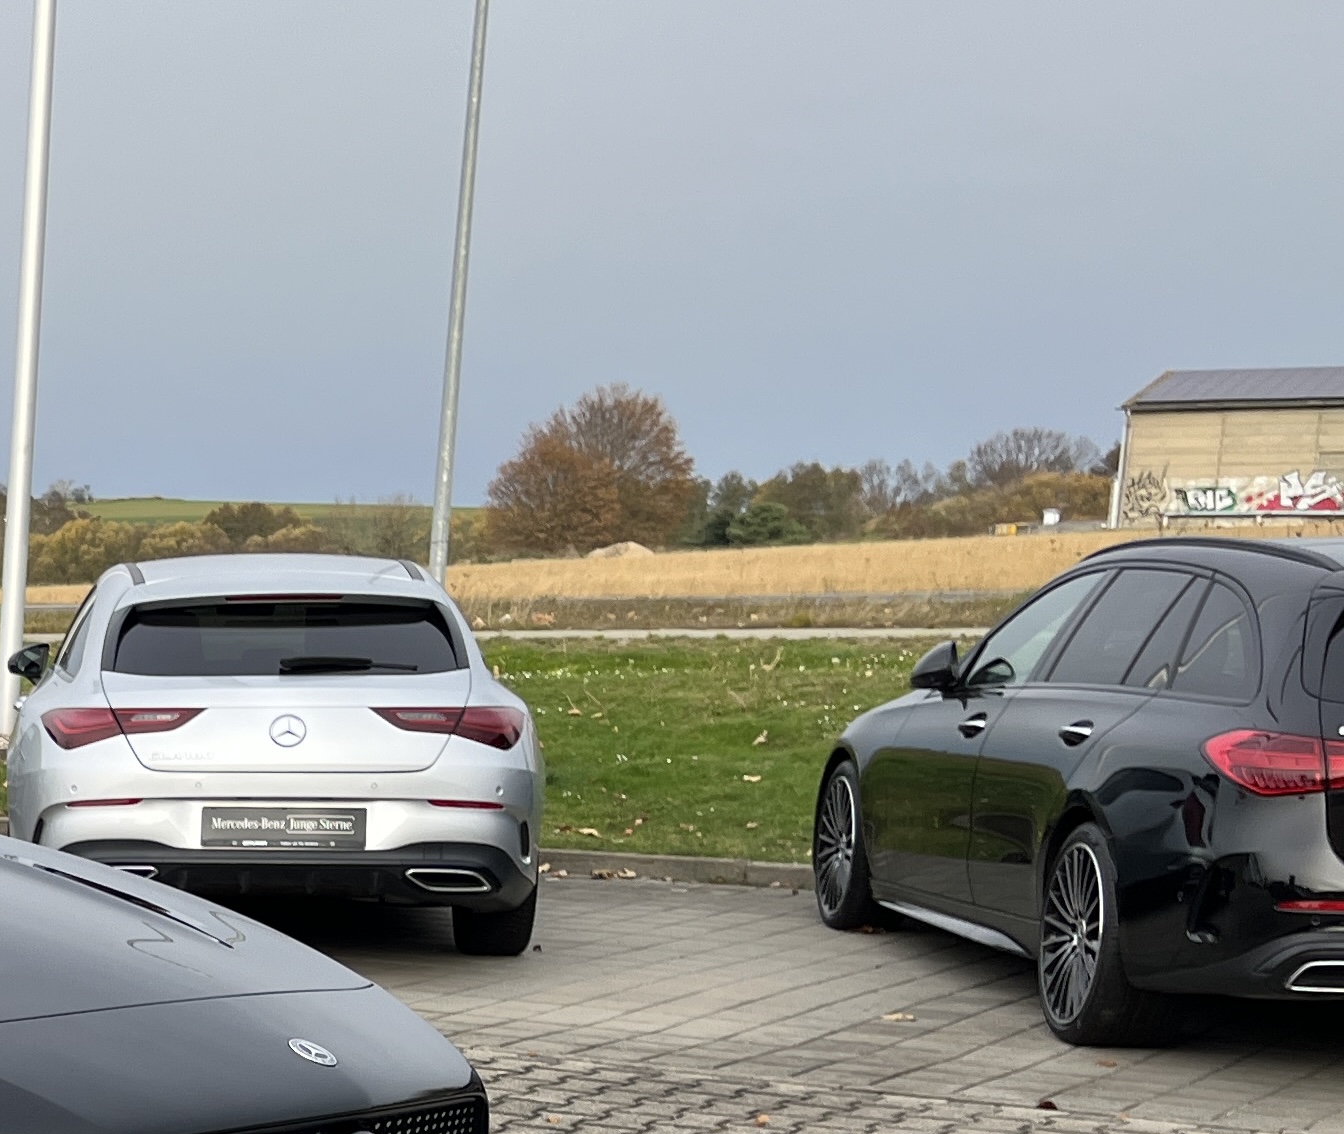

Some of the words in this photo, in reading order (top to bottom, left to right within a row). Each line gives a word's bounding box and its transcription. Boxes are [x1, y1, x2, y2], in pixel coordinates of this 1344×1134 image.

[211, 816, 286, 831] Mercedes-Benz
[289, 817, 318, 832] Junge
[319, 817, 353, 831] Sterne
